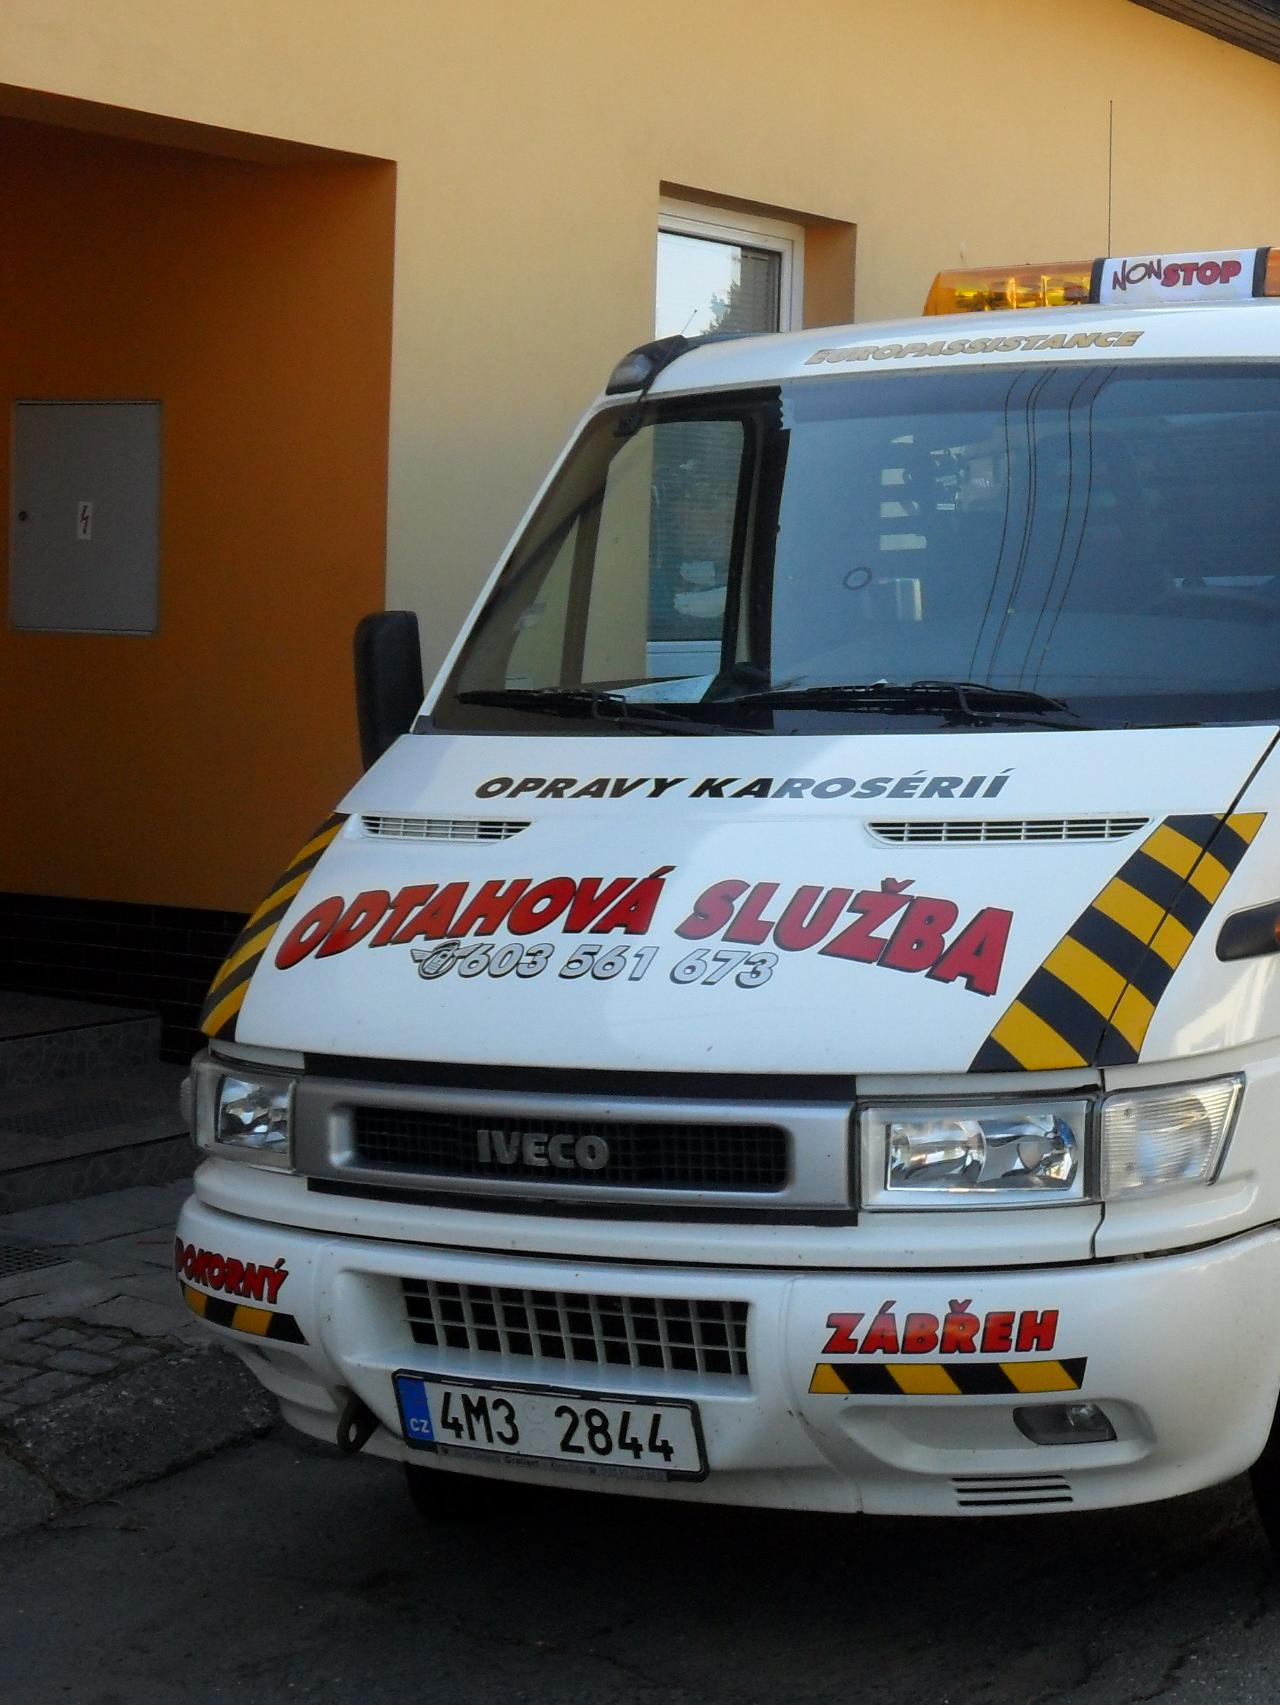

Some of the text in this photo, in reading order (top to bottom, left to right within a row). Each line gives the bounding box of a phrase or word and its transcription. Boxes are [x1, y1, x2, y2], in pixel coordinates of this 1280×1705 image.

[804, 331, 1145, 365] EUROPASSISTANCE
[475, 767, 1017, 799] OPRAVY KAROSÉRIÍ
[274, 865, 1014, 997] ODTAHOVÁ SLUŽBA
[457, 943, 779, 990] 603 561 673
[477, 1129, 610, 1170] IVECO
[821, 1299, 1059, 1354] ZÁBŘEH
[409, 1391, 675, 1463] CZ 4M3 2844
